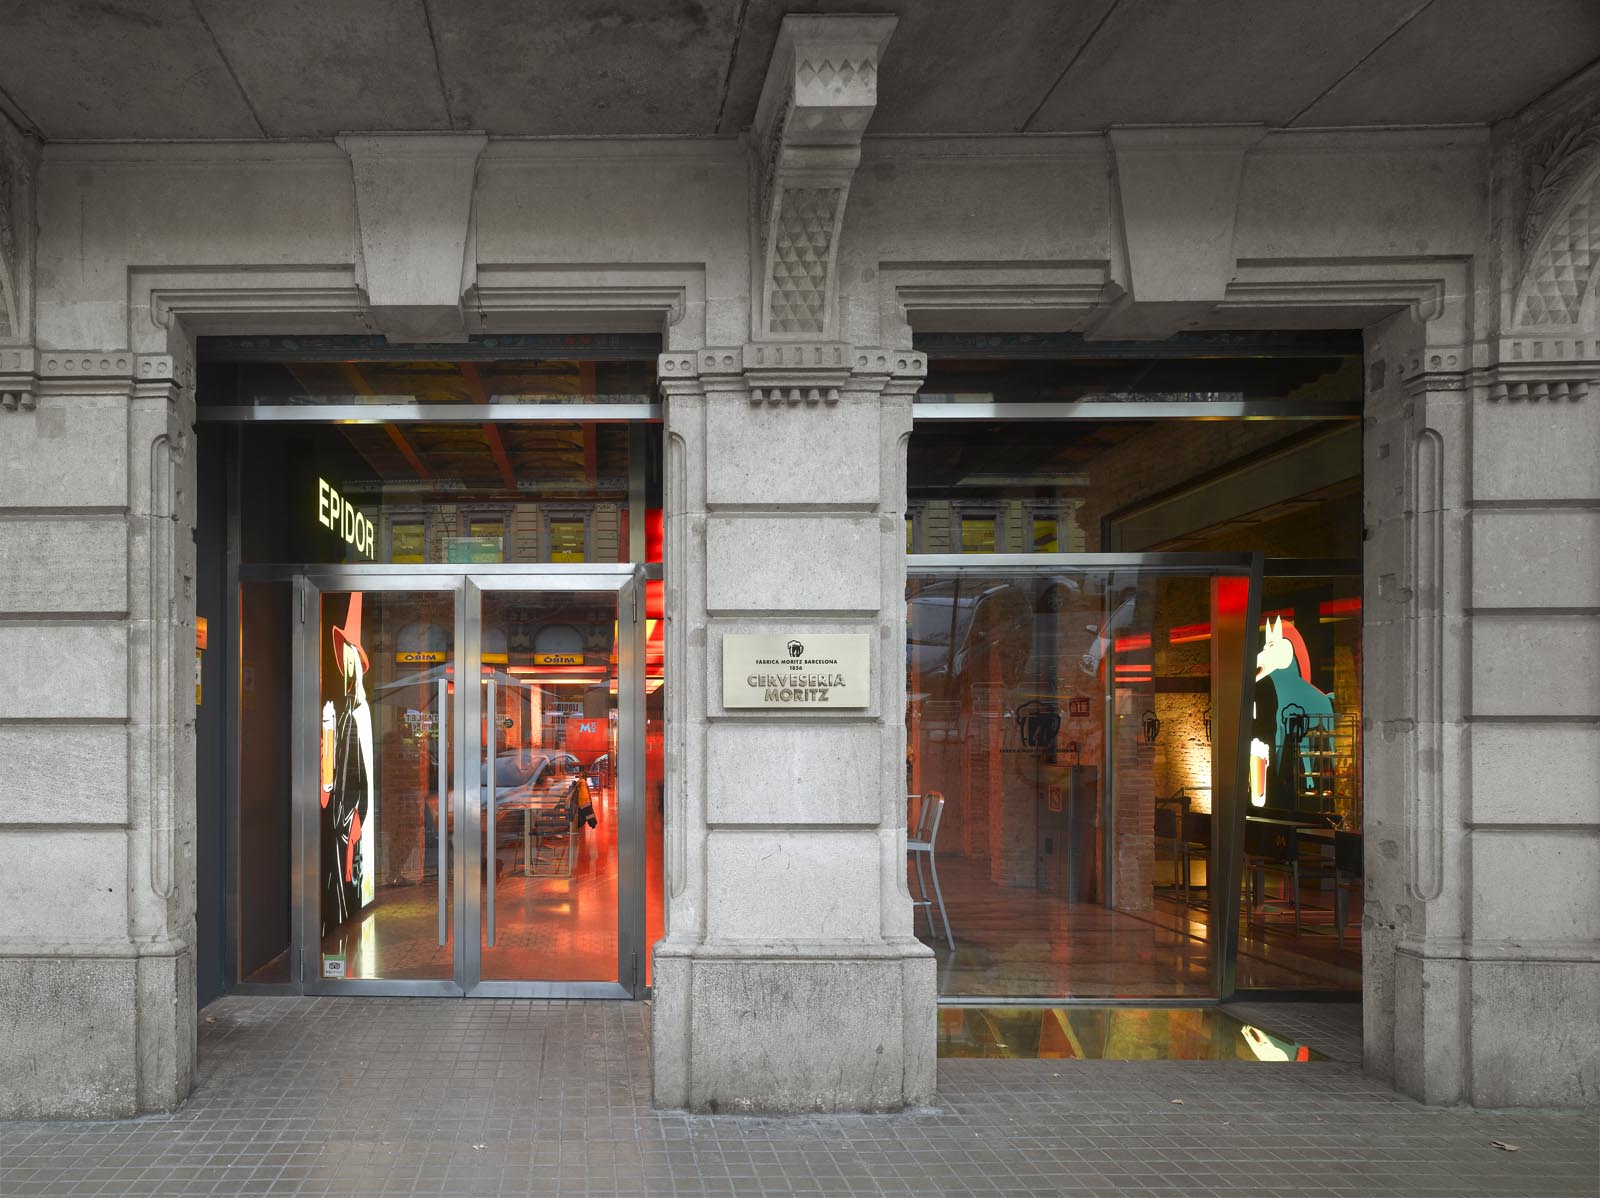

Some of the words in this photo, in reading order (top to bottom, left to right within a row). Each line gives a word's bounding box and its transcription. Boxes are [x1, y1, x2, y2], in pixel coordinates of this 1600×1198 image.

[319, 476, 374, 561] EPIDOR
[747, 673, 846, 687] CERVESERIA
[764, 688, 829, 702] MORITZ
